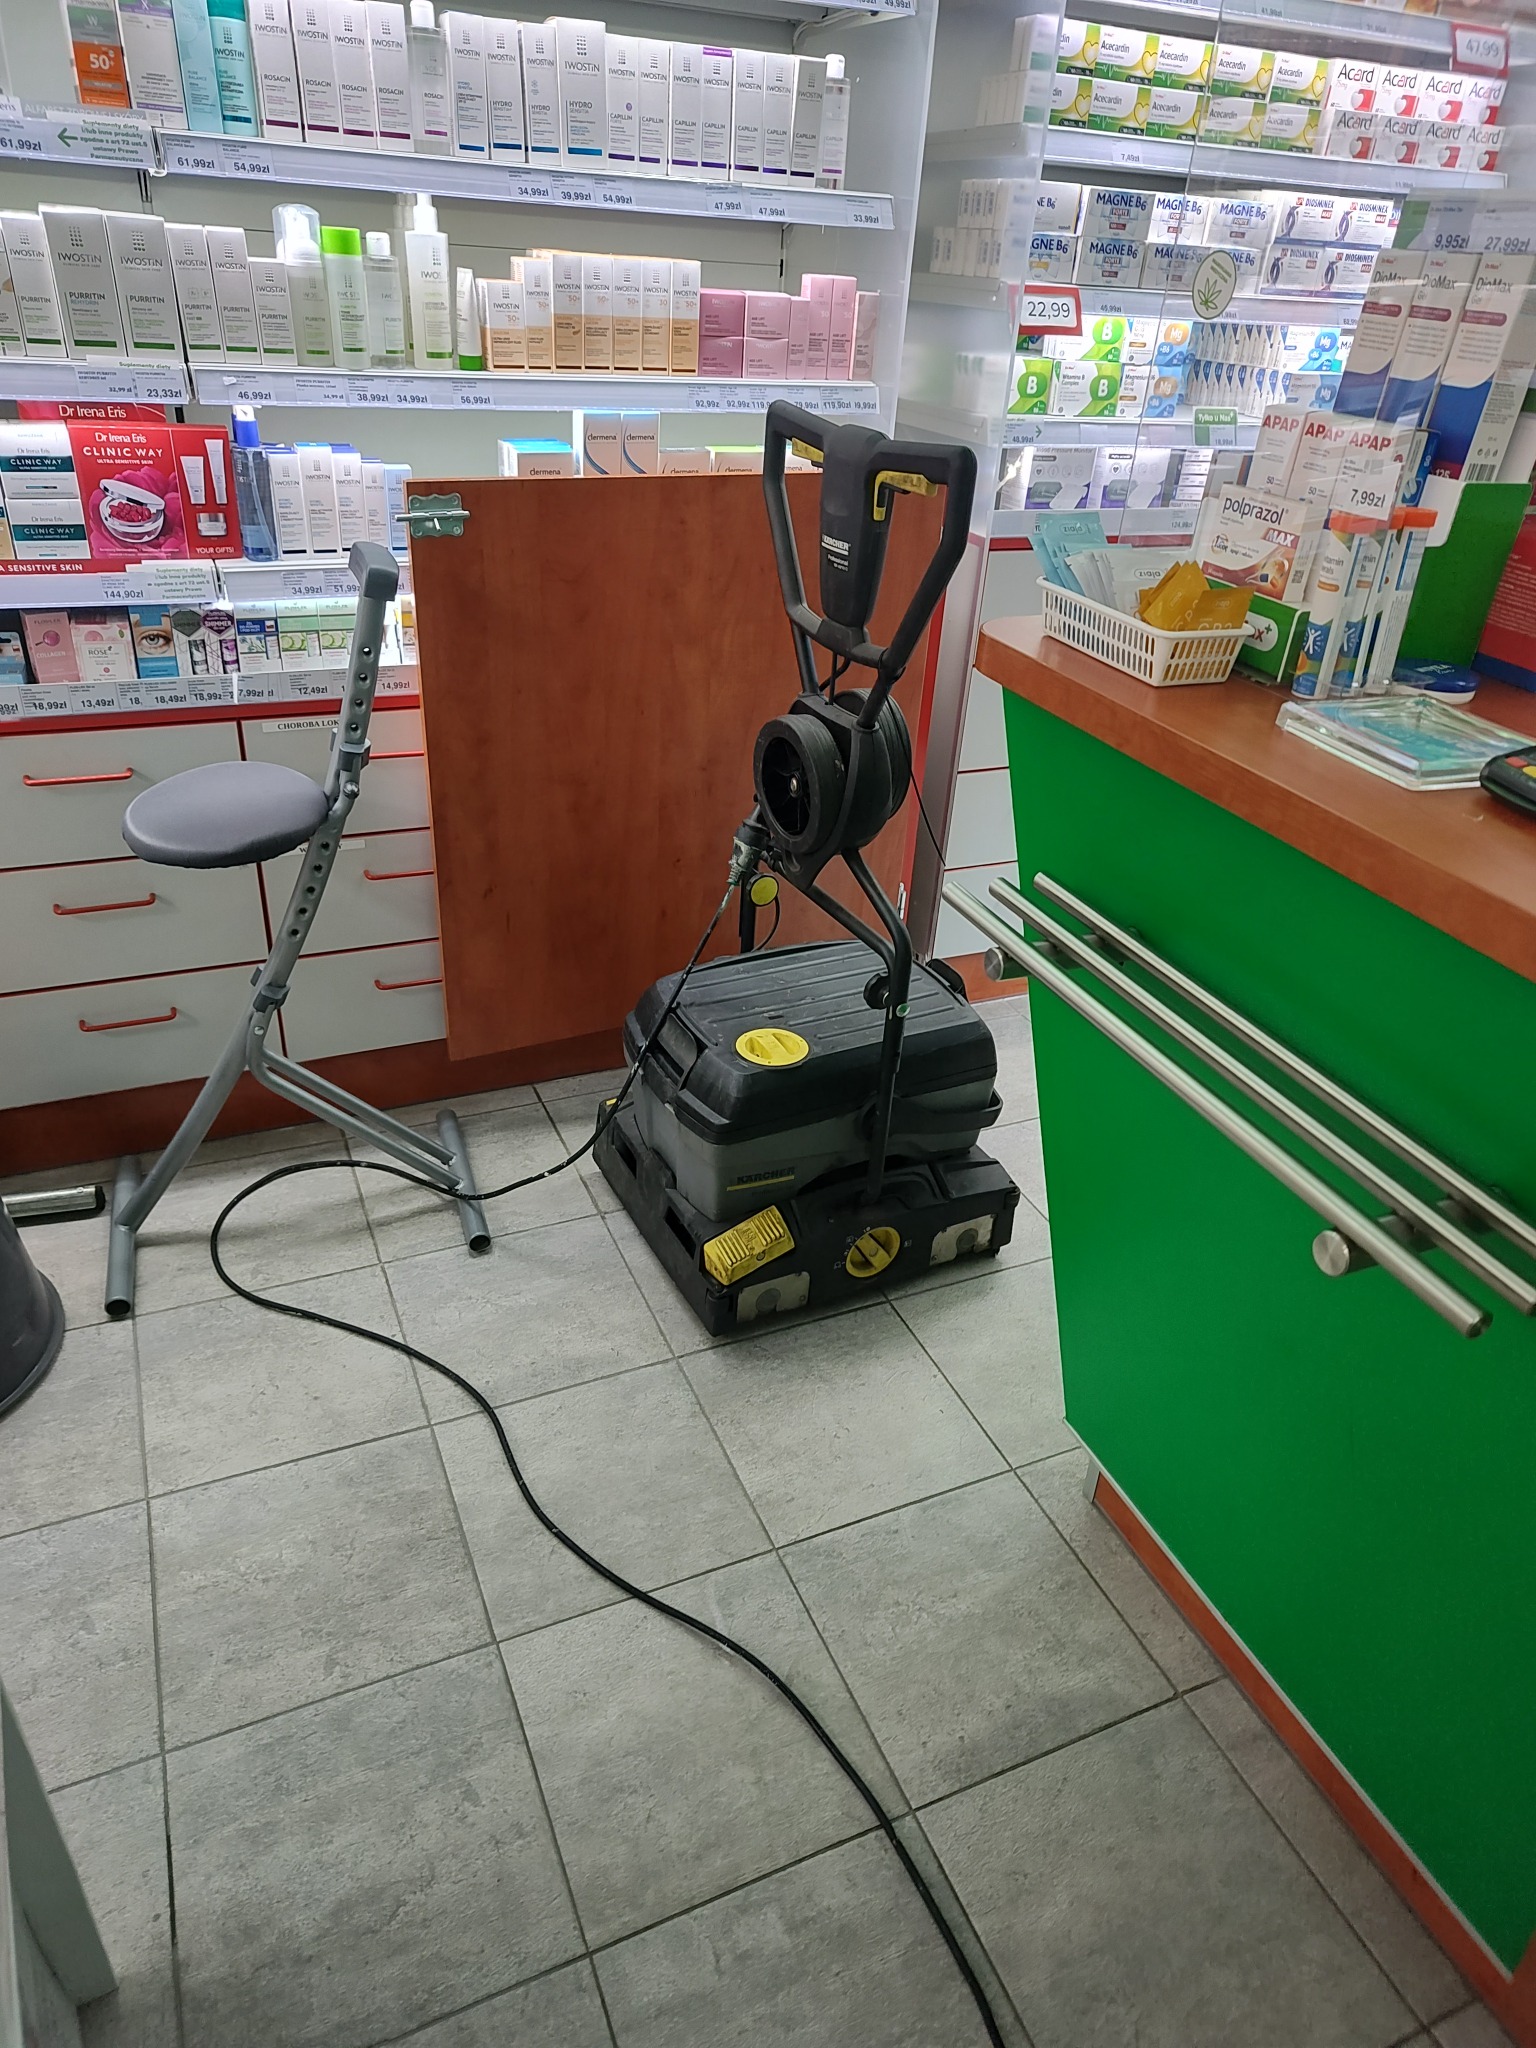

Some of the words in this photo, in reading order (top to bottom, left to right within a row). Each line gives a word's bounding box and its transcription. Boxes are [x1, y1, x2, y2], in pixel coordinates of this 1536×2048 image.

[1101, 39, 1130, 53] Acecardin
[214, 48, 245, 59] IWOSTIN
[1159, 50, 1188, 62] Acecardin
[1218, 58, 1246, 71] Acecardin
[1278, 65, 1303, 78] Acecardin
[1338, 63, 1375, 84] Acard
[263, 74, 291, 83] ROSACIN
[305, 78, 331, 88] ROSACIN
[1382, 70, 1418, 89] Acard
[341, 83, 367, 93] ROSACIN
[379, 87, 404, 96] ROSACIN
[1426, 76, 1463, 95] Acard
[1468, 81, 1503, 100] Acard
[493, 100, 513, 108] HYDRO
[569, 100, 593, 109] HYDRO
[1093, 92, 1122, 106] Acecardin
[1152, 101, 1181, 113] Acecardin
[609, 112, 633, 121] CAPILLIN
[641, 116, 664, 124] CAPILLIN
[1210, 108, 1238, 120] Acecardin
[82, 118, 122, 129] Suplementy
[122, 122, 139, 131] diety
[674, 119, 697, 127] CAPILLIN
[704, 122, 726, 130] CAPILLIN
[1337, 111, 1375, 131] Acard
[1382, 116, 1419, 136] Acard
[738, 125, 758, 133] CAPILLIN
[766, 128, 787, 136] CAPILLIN
[1426, 122, 1462, 141] Acard
[795, 132, 816, 140] CAPILLIN
[1466, 127, 1500, 145] Acard
[92, 146, 114, 154] ustawy
[1096, 192, 1134, 207] MAGNE
[1135, 194, 1147, 212] B6
[1156, 197, 1190, 212] MAGNE
[1191, 200, 1202, 215] B6
[1305, 198, 1335, 209] DIOSMINEX
[1358, 202, 1388, 214] DIOSMINEX
[1112, 208, 1129, 216] FORTE
[1220, 202, 1254, 218] MAGNE
[1256, 206, 1266, 220] B6
[1089, 240, 1125, 256] MAGNE
[1126, 243, 1138, 259] B6
[1290, 248, 1320, 260] DIOSMINEX
[58, 252, 102, 264] IWOSTIN
[120, 256, 163, 267] IWOSTIN
[1104, 256, 1120, 264] FORTE
[1245, 252, 1255, 266] B6
[1344, 252, 1375, 264] DIOSMINEX
[1422, 274, 1458, 289] DioMax
[1476, 277, 1513, 293] DioMax
[20, 296, 51, 304] PURRITIN
[69, 292, 106, 300] PURRITIN
[130, 294, 165, 304] PURRITIN
[1027, 301, 1071, 318] 22,99
[261, 313, 288, 321] PURRITIN
[1102, 322, 1113, 340] B
[1170, 327, 1183, 340] Mg
[1320, 336, 1331, 348] Mg
[118, 362, 154, 370] Suplementy
[1026, 376, 1037, 394] B
[1098, 379, 1108, 397] B
[1159, 380, 1172, 393] Mg
[1320, 386, 1331, 398] Mg
[58, 404, 74, 418] Dr
[76, 404, 106, 418] Irena
[106, 406, 126, 418] Eris
[1198, 413, 1214, 422] Tylko
[1220, 414, 1231, 422] Nas
[1263, 414, 1299, 433] APAP
[95, 432, 106, 442] Dr
[108, 432, 130, 443] Irena
[132, 433, 147, 444] Eris
[587, 433, 617, 442] dermena
[626, 433, 655, 442] dermena
[1304, 422, 1345, 442] APAP
[1349, 430, 1392, 452] APAP
[83, 446, 130, 457] CLINIC
[134, 448, 164, 458] WAY
[10, 458, 41, 466] CLINIC
[43, 458, 62, 466] WAY
[529, 466, 561, 477] dermena
[1266, 476, 1274, 485] 50
[1308, 486, 1317, 496] 50
[1223, 496, 1284, 526] polprazol
[24, 527, 55, 535] CLINIC
[1266, 529, 1296, 548] MAX
[8, 564, 58, 572] SENSITIVE
[60, 563, 83, 572] SKIN
[1139, 570, 1161, 578] ziaja
[36, 651, 66, 659] COLLAGEN
[278, 721, 320, 730] CHOROBA
